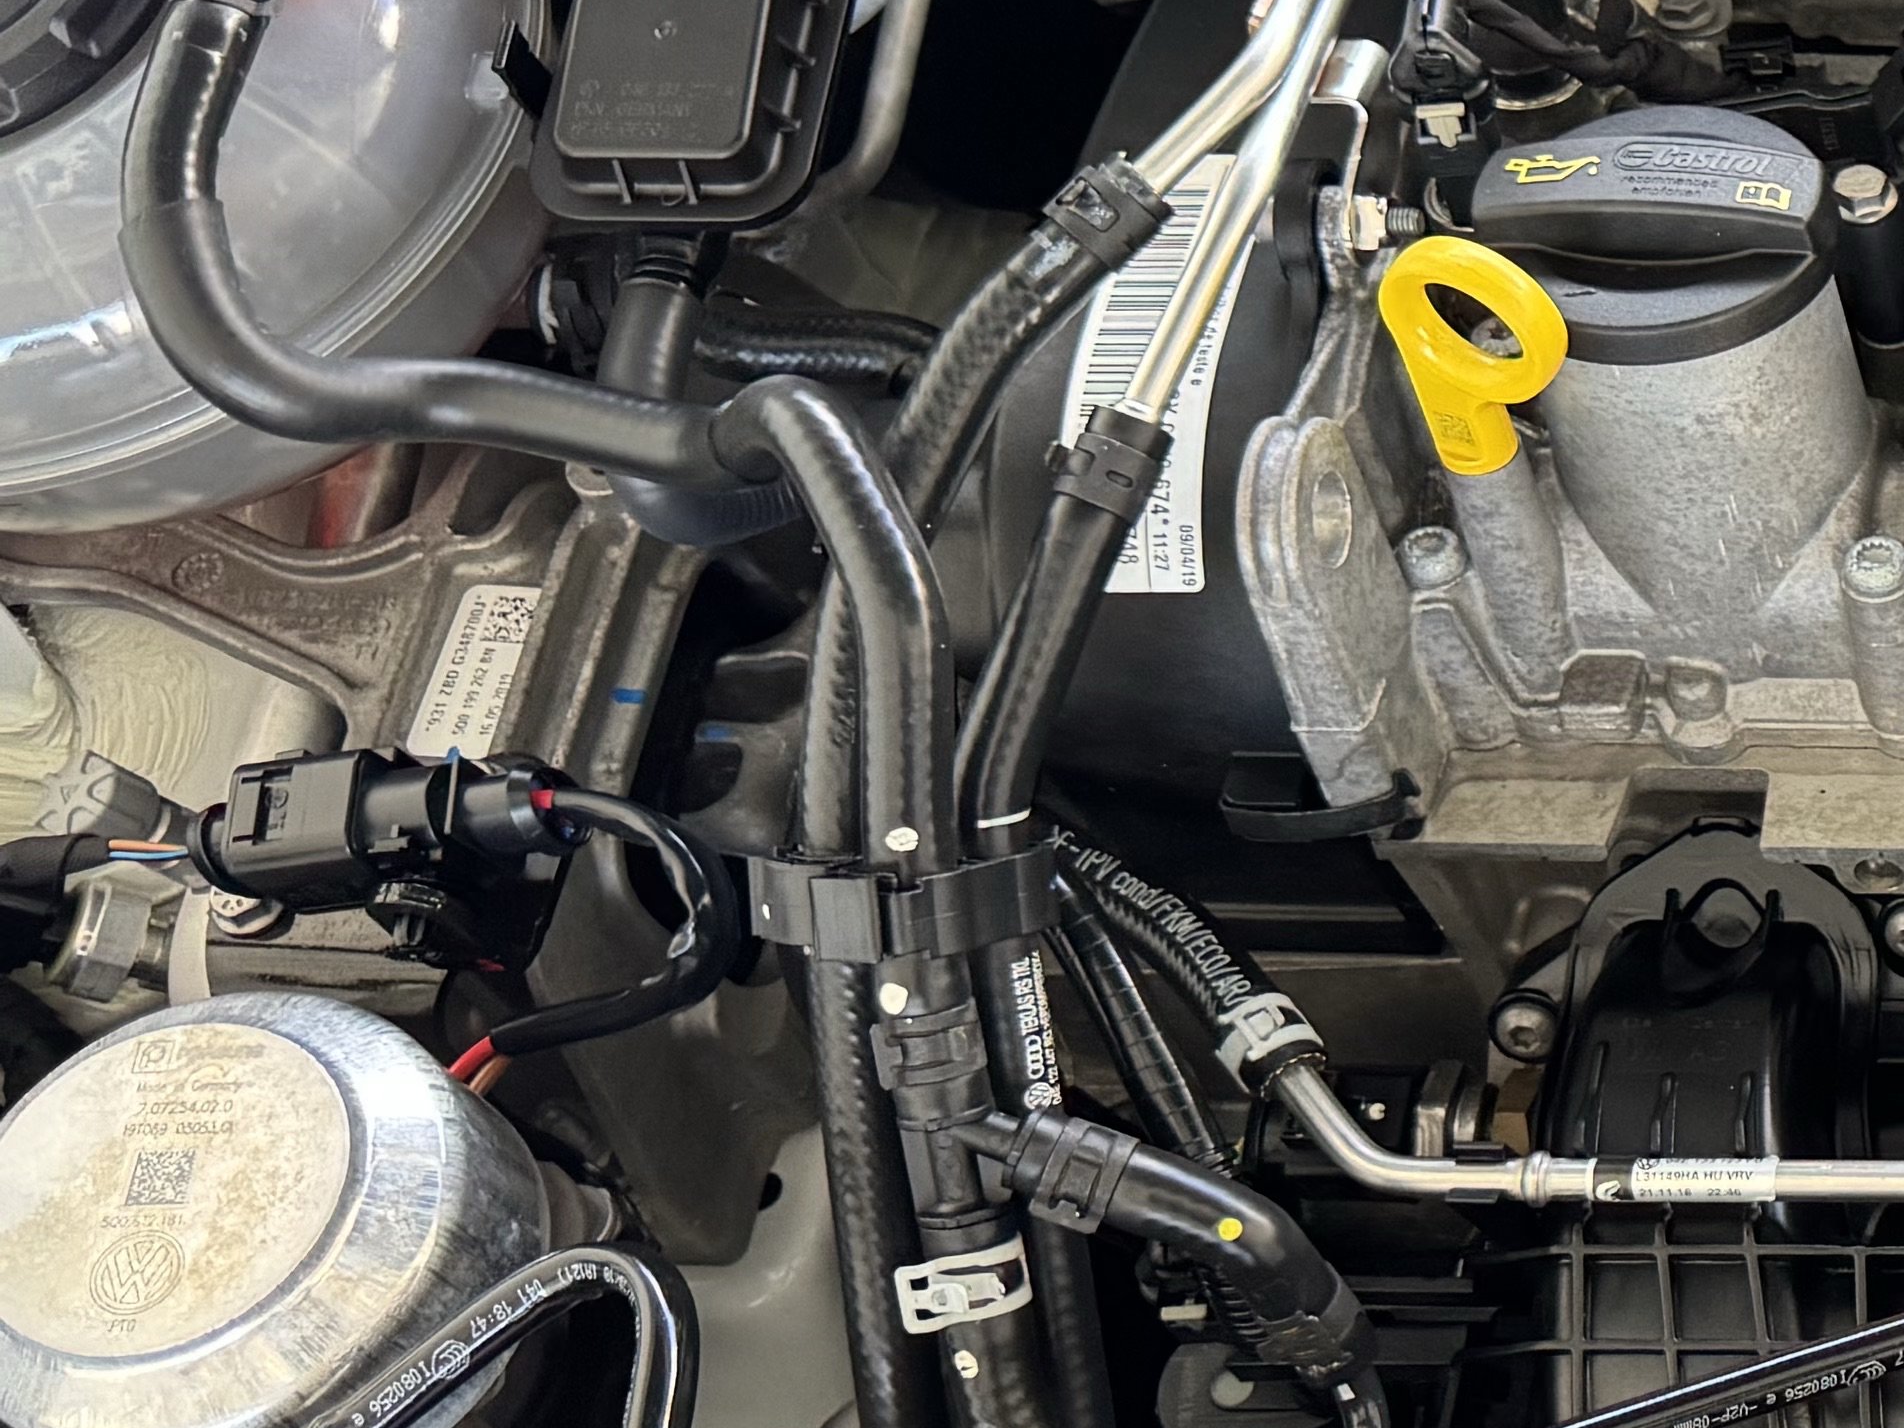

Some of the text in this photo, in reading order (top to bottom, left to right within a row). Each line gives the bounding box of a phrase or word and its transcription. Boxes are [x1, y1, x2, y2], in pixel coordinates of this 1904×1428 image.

[1654, 146, 1772, 176] Castrol
[1621, 175, 1718, 188] recommended
[1152, 531, 1168, 571] 11:27
[1178, 523, 1196, 587] 09/04/19
[469, 1300, 512, 1337] 18:47
